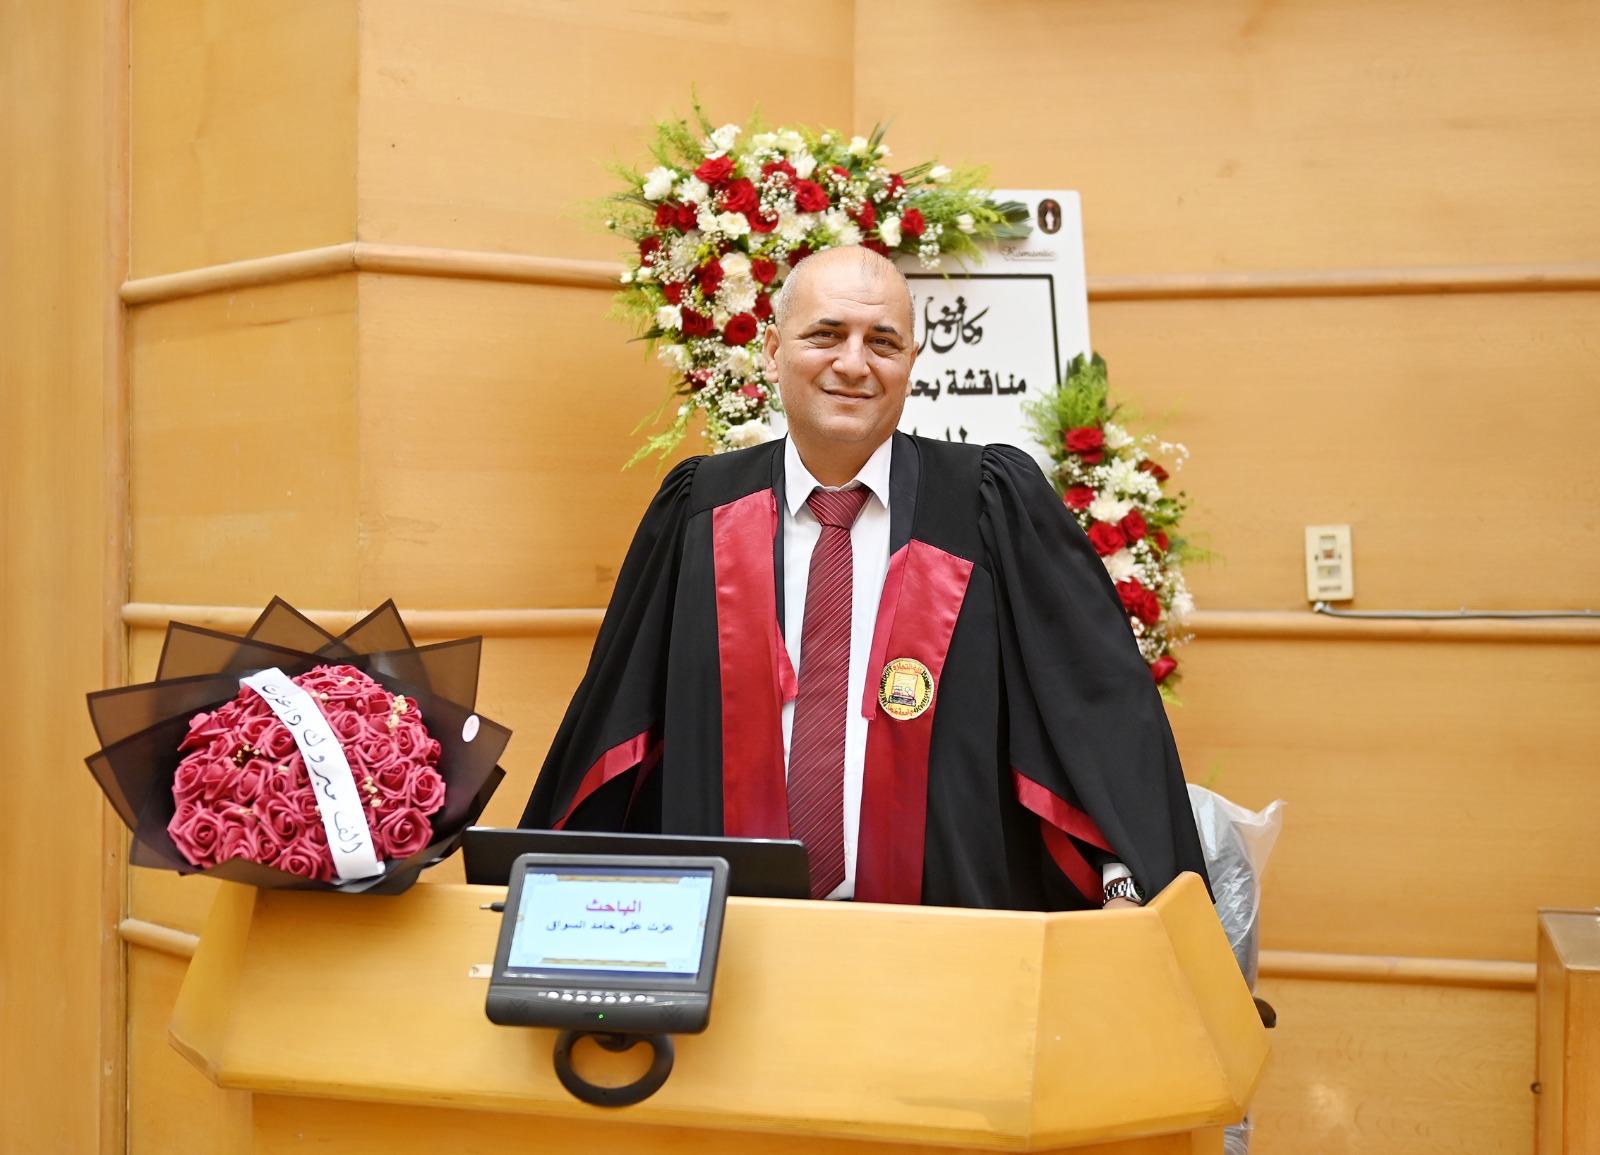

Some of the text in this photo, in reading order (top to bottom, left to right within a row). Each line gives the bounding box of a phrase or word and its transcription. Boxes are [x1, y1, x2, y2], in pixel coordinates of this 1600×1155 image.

[910, 368, 1027, 402] مناقشة بح
[585, 898, 642, 916] الباحث
[646, 922, 674, 934] عزت
